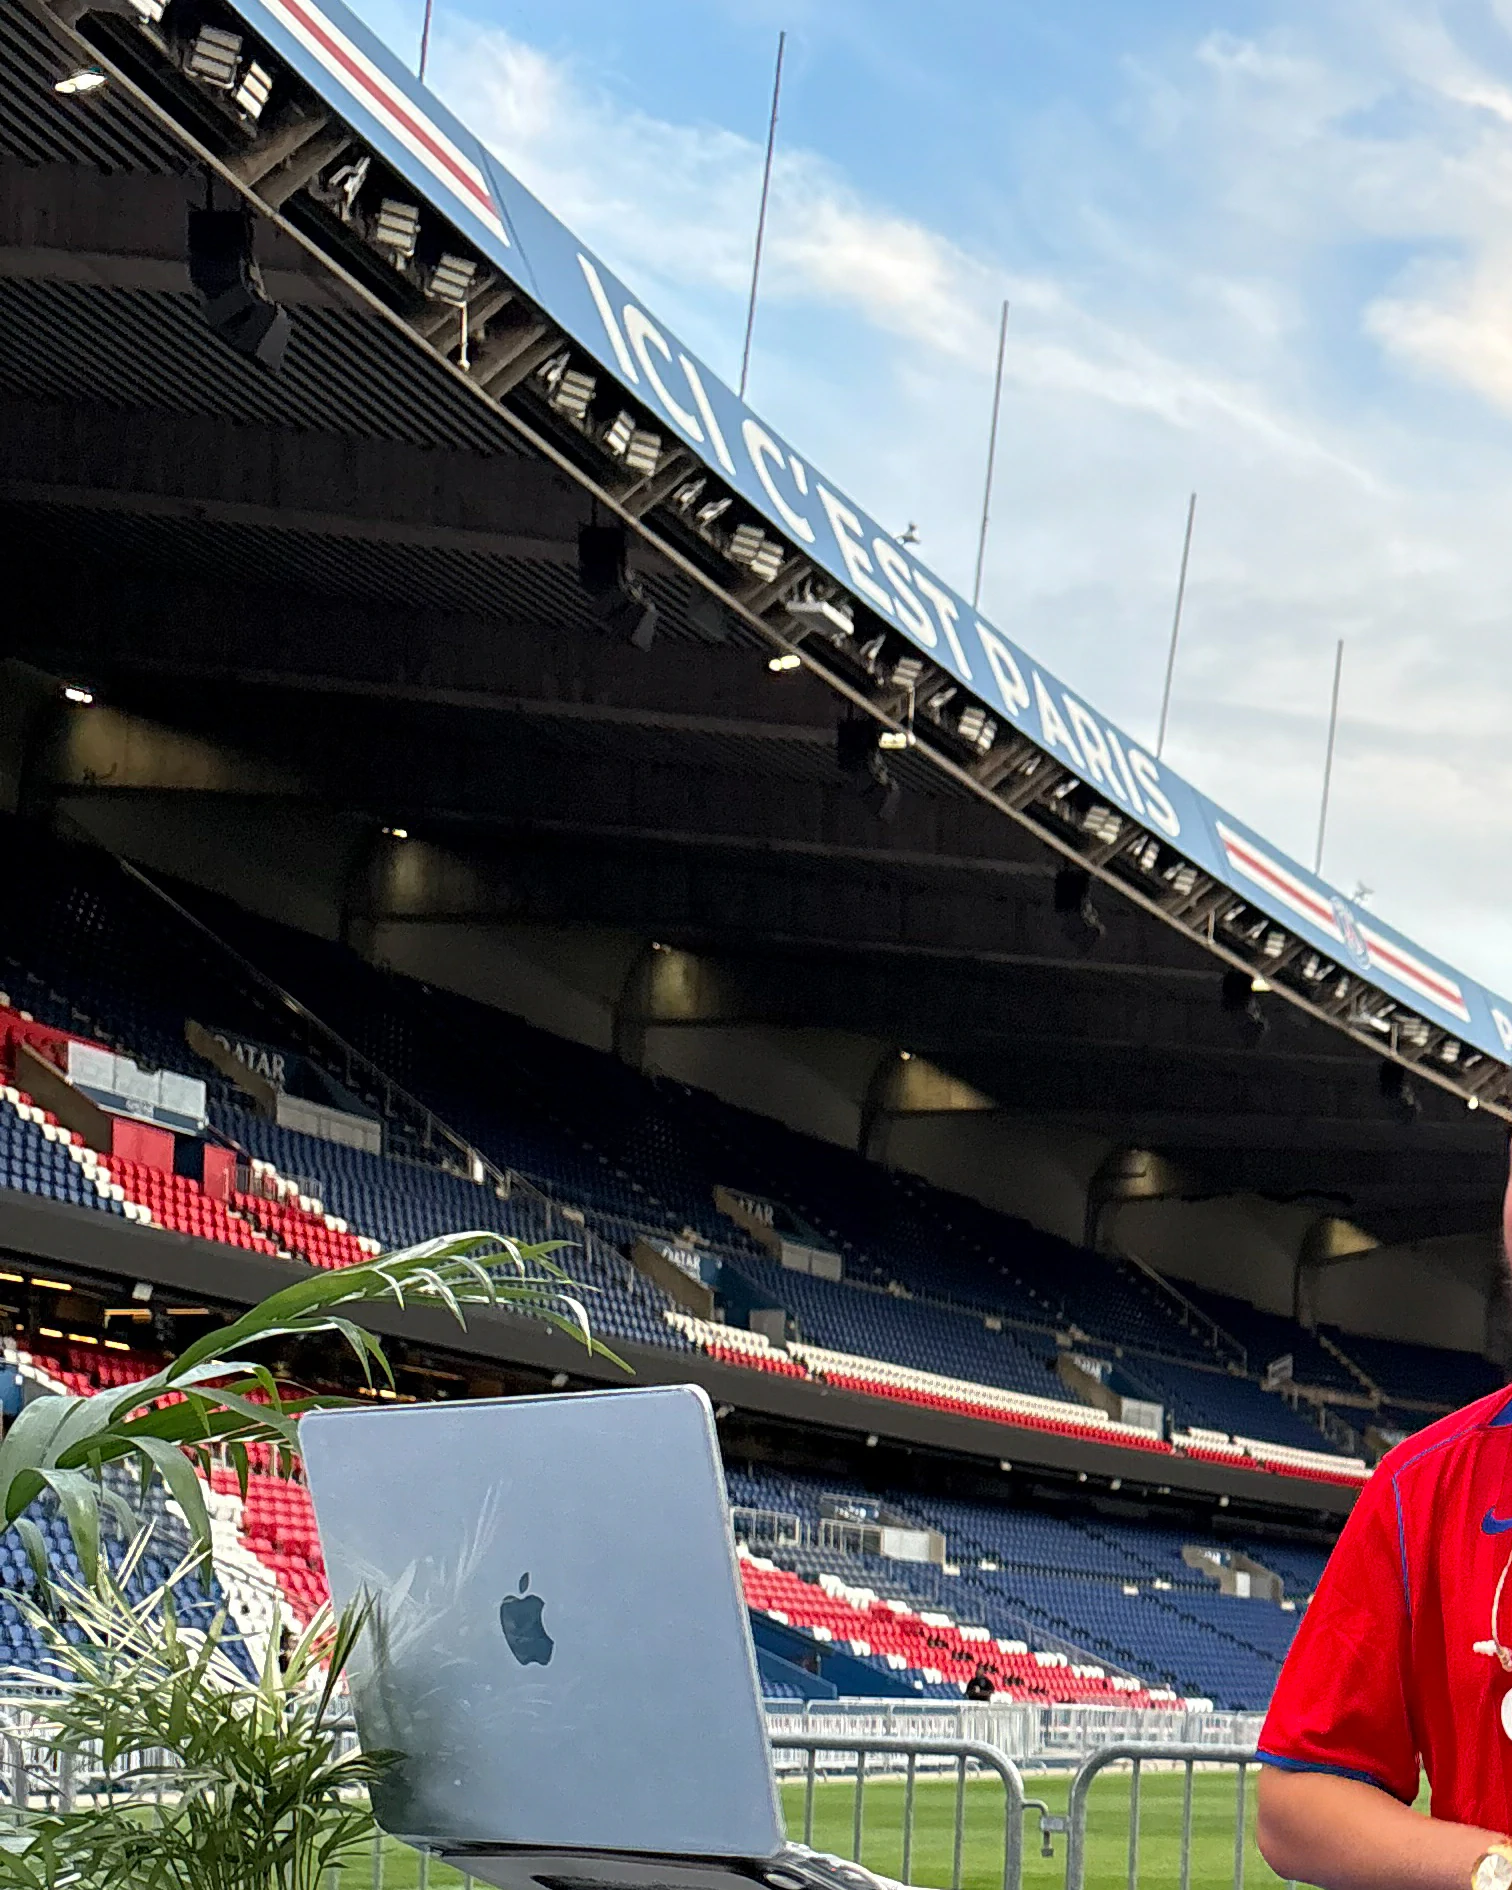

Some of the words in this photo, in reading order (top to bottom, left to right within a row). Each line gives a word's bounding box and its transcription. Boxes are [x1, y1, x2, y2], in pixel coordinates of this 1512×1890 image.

[576, 252, 737, 477] ICI
[741, 418, 973, 682] C'EST
[974, 620, 1181, 838] PARIS
